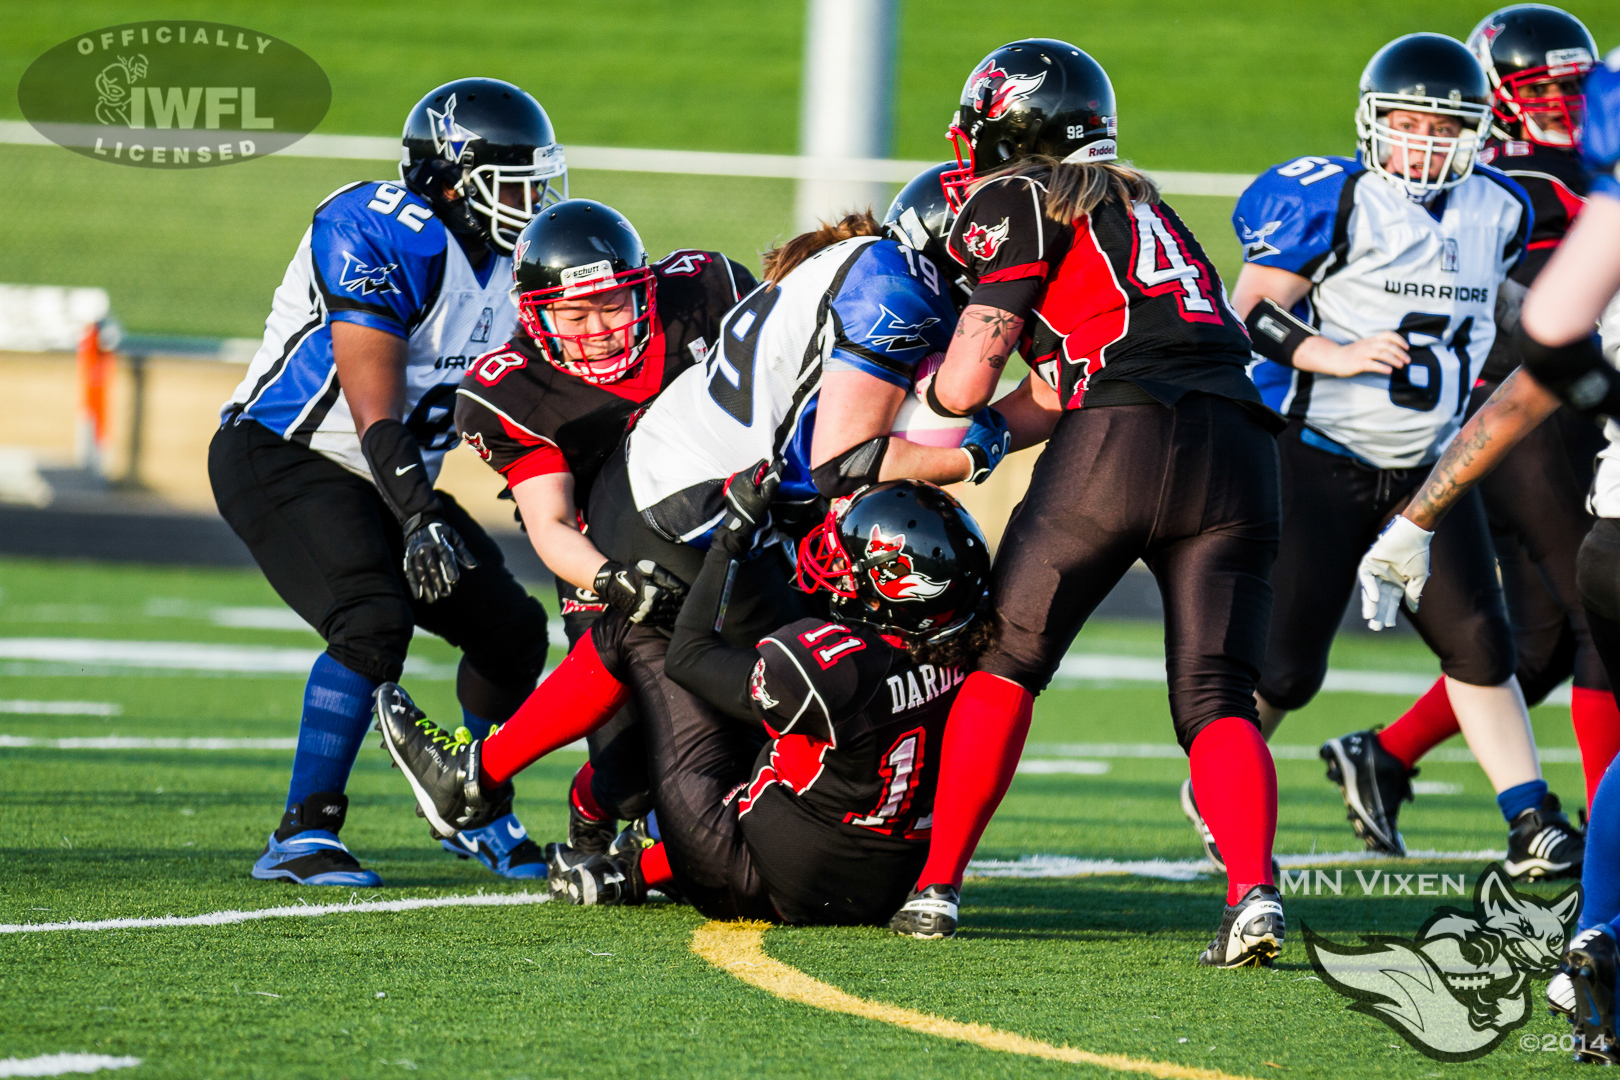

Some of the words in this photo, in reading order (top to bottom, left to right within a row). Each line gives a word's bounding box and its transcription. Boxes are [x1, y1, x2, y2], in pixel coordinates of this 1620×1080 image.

[1066, 124, 1085, 140] 92
[1276, 155, 1346, 187] 61
[366, 182, 434, 234] 92
[896, 243, 941, 297] 19
[1128, 197, 1247, 340] 4
[1384, 279, 1488, 304] WARRIORS
[706, 281, 782, 427] 9
[1389, 311, 1475, 416] 61
[798, 622, 867, 670] 11
[843, 726, 934, 840] 1
